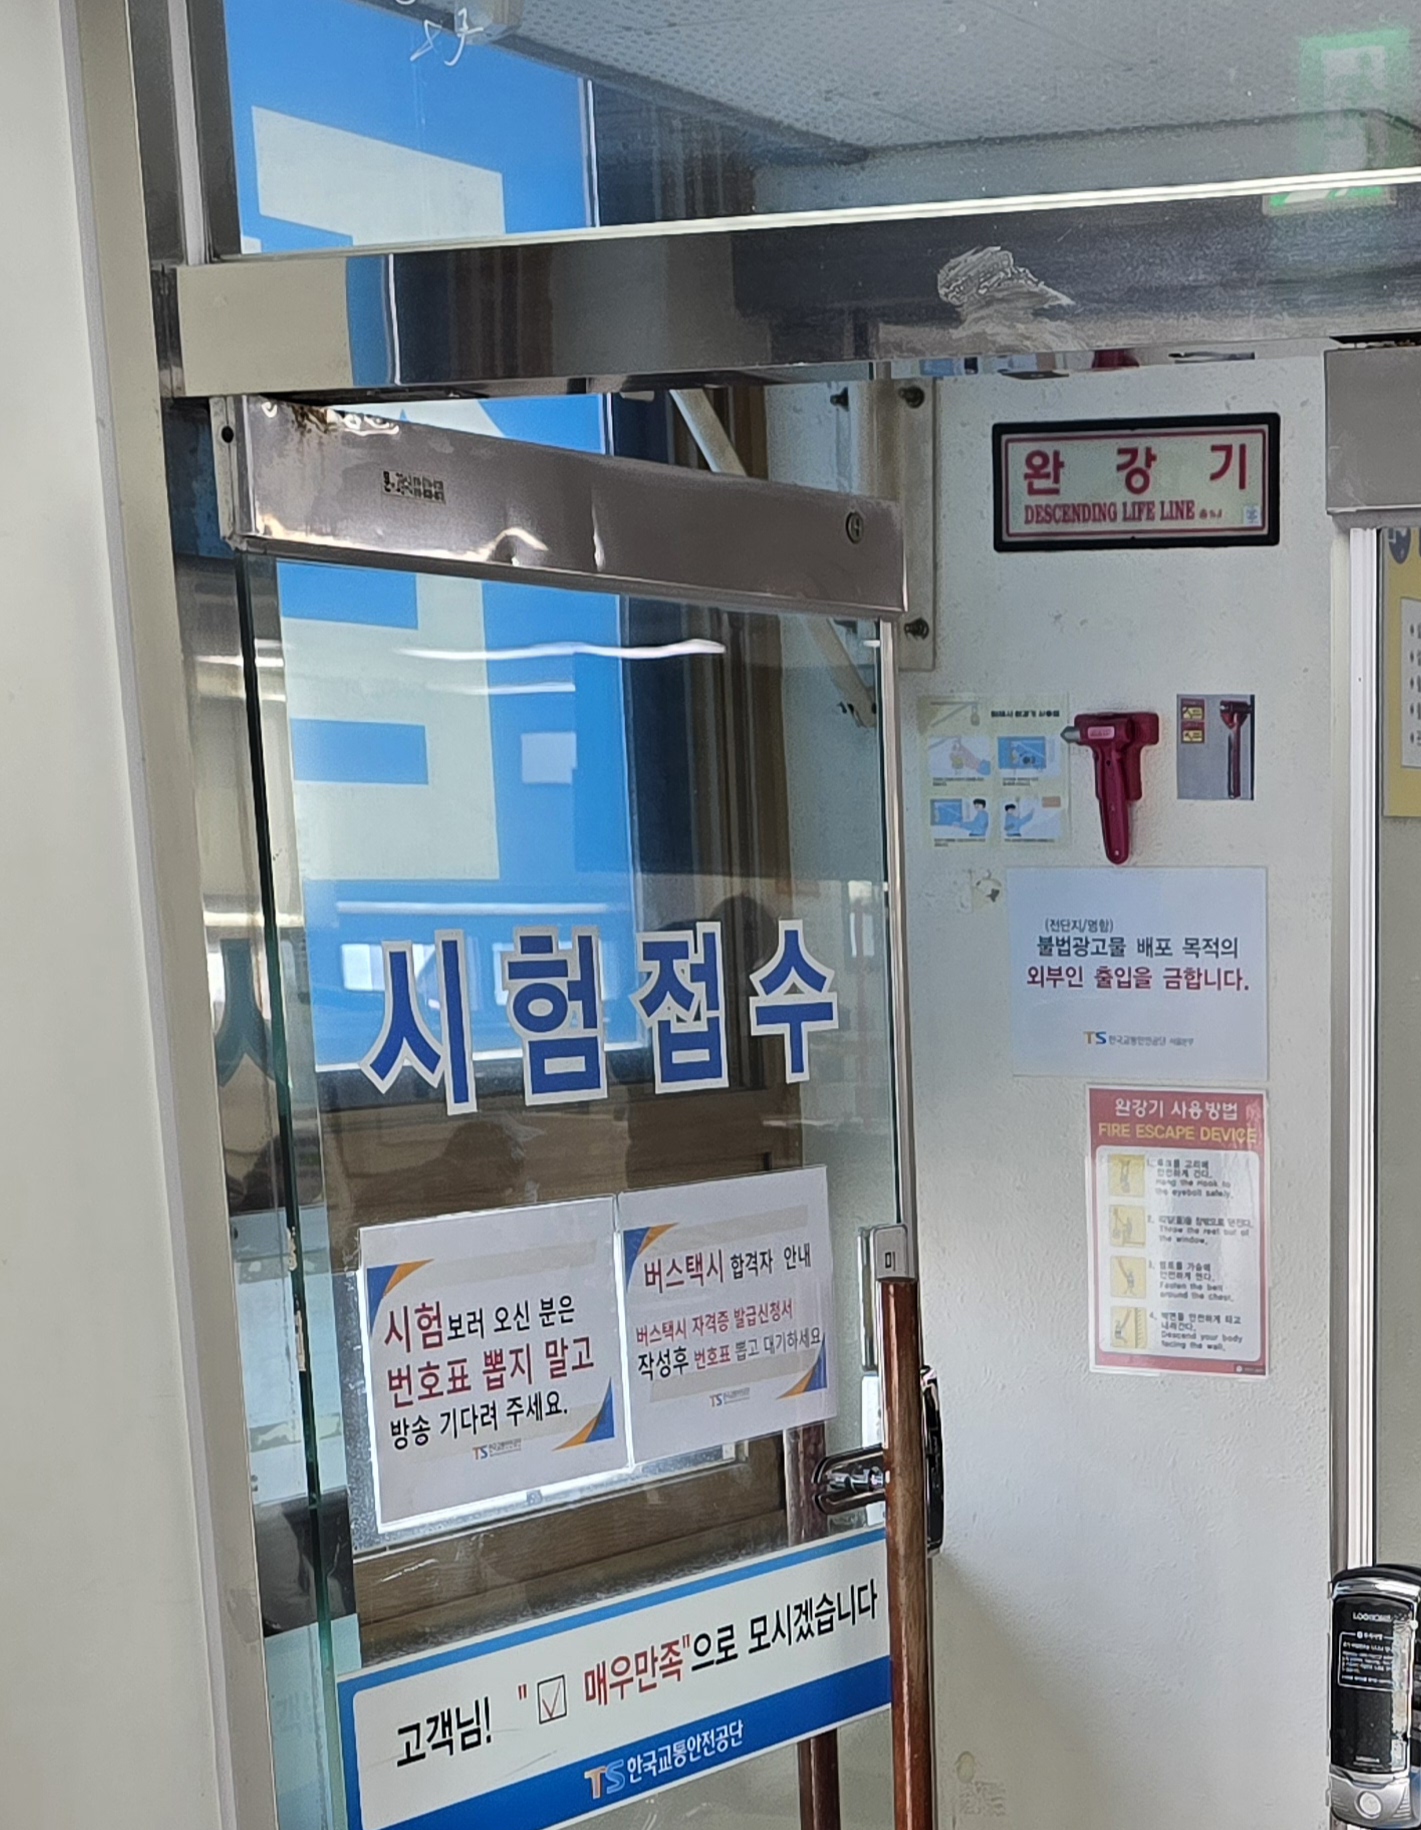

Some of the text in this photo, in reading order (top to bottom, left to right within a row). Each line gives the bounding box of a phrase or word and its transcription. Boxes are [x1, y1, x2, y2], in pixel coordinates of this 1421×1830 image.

[1024, 501, 1117, 525] DESCENDING
[1122, 500, 1155, 522] LIFE
[1159, 500, 1195, 521] LINE
[1036, 935, 1239, 959] 불법광고물 배포 목적의
[1026, 965, 1250, 991] 외부인 출입을 금합니다.
[360, 920, 838, 1115] 시험접수
[1083, 1031, 1107, 1045] TS
[1098, 1122, 1257, 1143] FIRE ESCAPE DEVICE
[1115, 1098, 1238, 1121] 완강기 사용방법
[644, 1242, 812, 1294] 버스택시 합격자 안내
[384, 1295, 575, 1353] 시험보러 오신 분은
[636, 1298, 793, 1347] 버스택시 자격증 발급신청서
[388, 1336, 594, 1409] 번호표 뽑지 말고
[638, 1345, 689, 1381] 작성후
[694, 1344, 731, 1370] 번호표
[734, 1338, 760, 1361] 뽑고
[390, 1390, 568, 1450] 방송 기다려 주세요.
[472, 1446, 488, 1460] TS
[396, 1696, 493, 1769] 고객님!
[747, 1578, 878, 1655] 모시겠습니다
[584, 1719, 744, 1800] TS 한국교통안전공단
